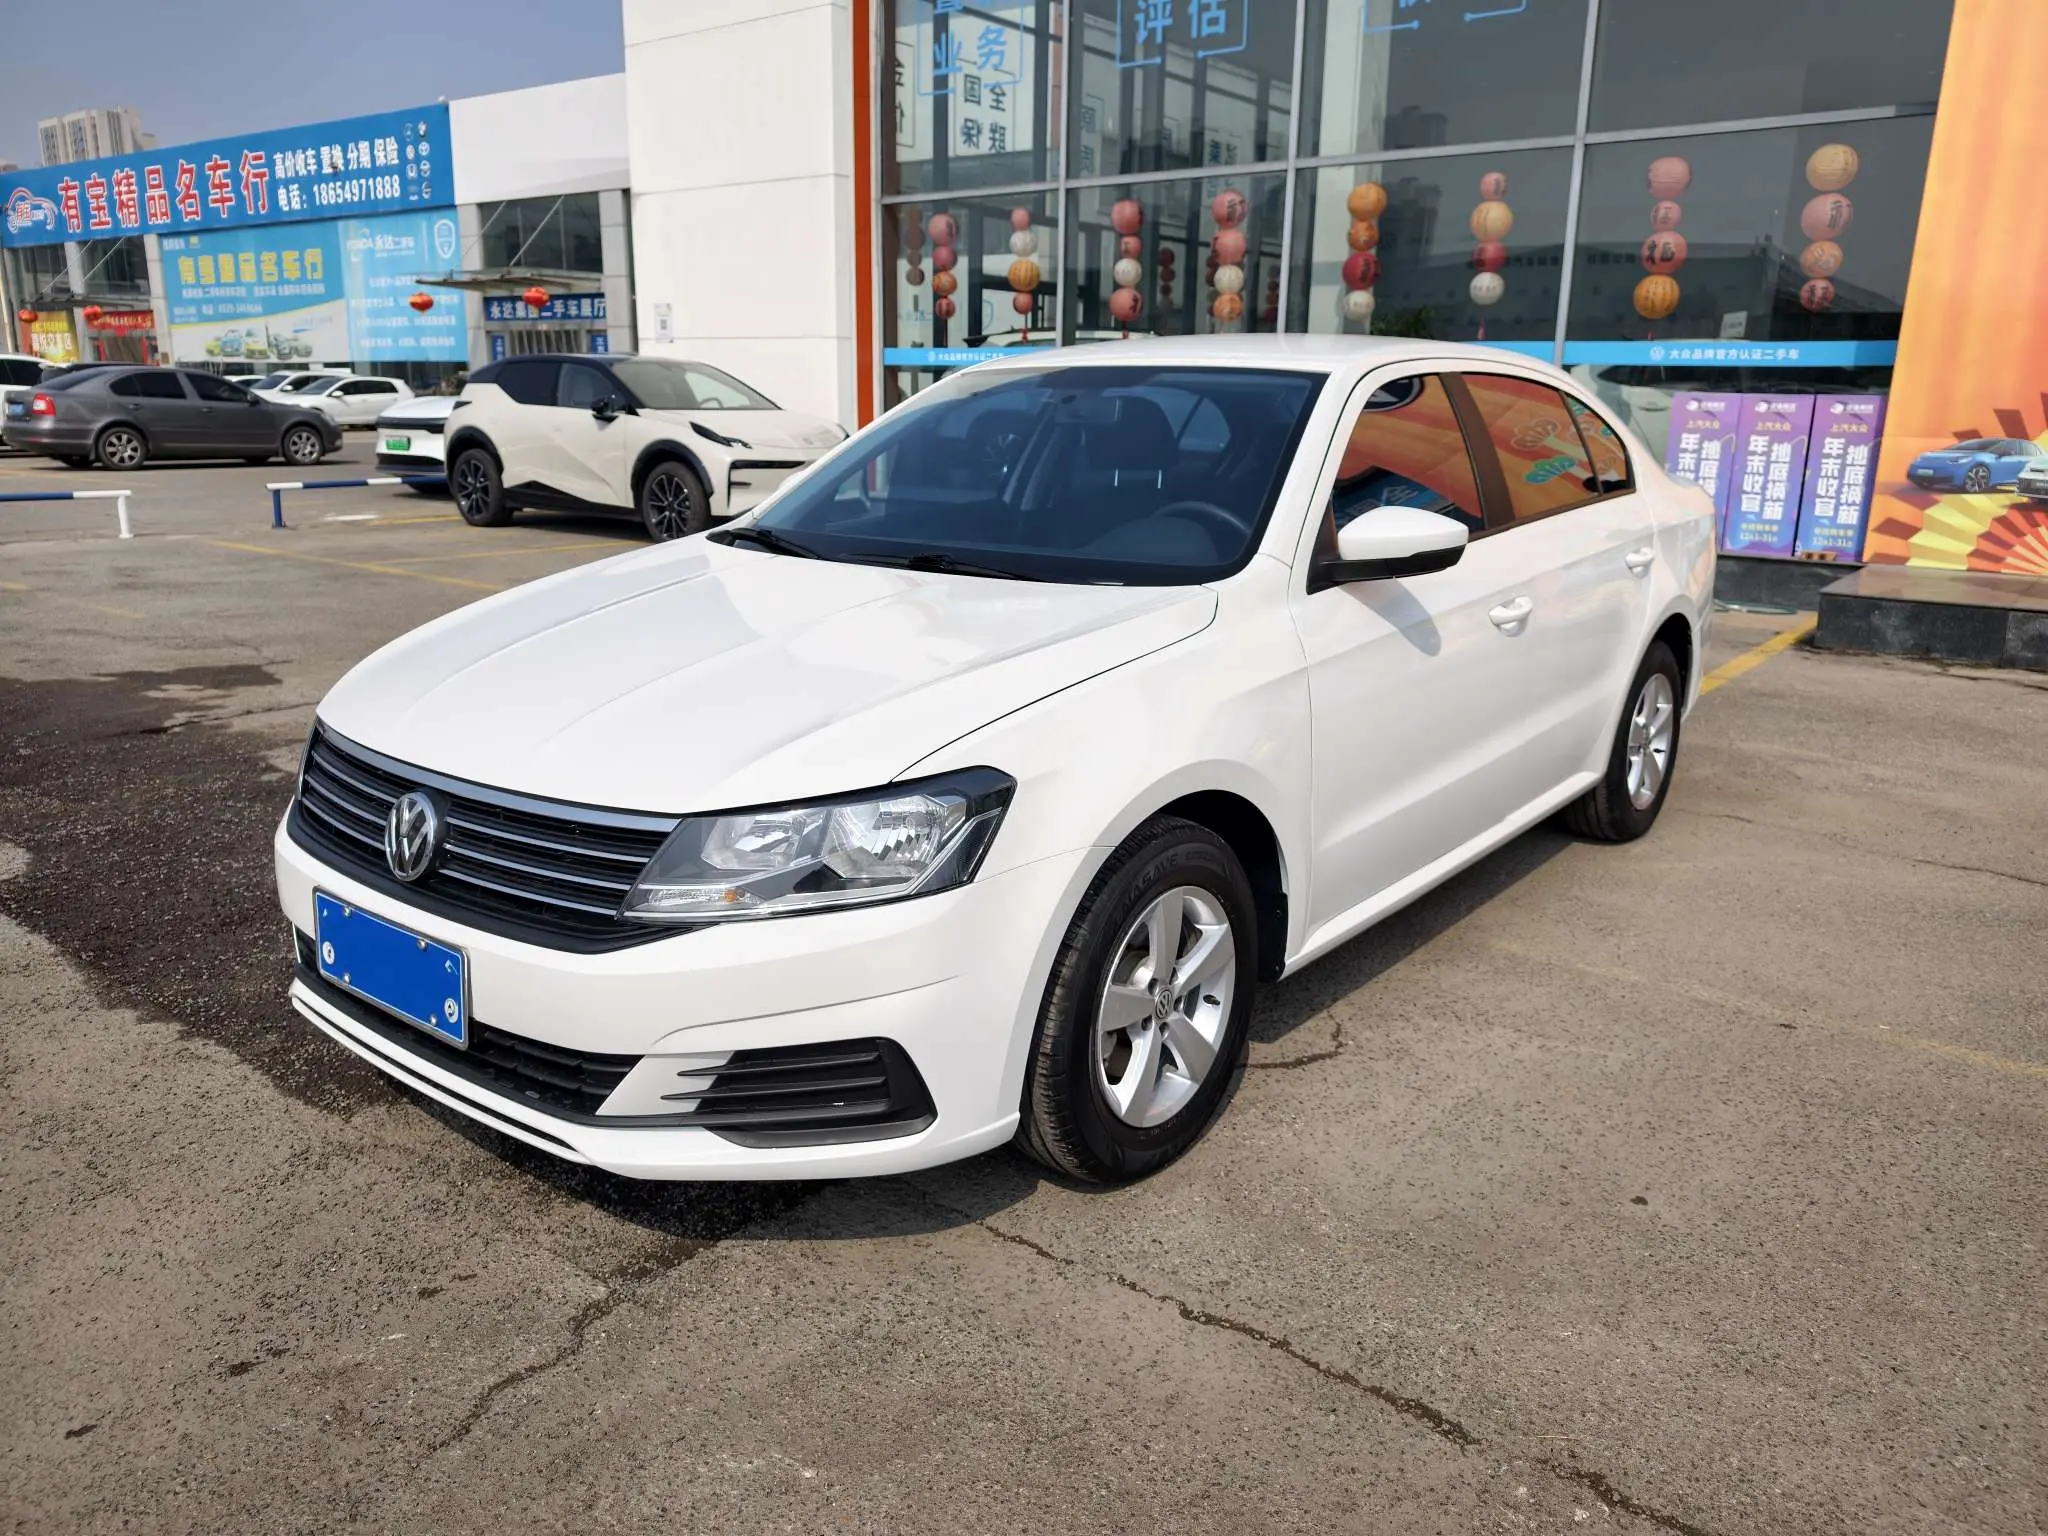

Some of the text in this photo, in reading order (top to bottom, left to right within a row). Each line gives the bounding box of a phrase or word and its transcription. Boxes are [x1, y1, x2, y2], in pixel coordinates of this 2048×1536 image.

[1134, 0, 1226, 44] 评估
[933, 26, 1007, 76] 业务
[273, 147, 318, 180] 高价收车
[347, 140, 372, 170] 分期
[374, 136, 399, 167] 保险
[58, 149, 270, 234] 有宝精品名车行
[1669, 348, 1800, 361] 大众品牌官方认证二手车
[1755, 421, 1792, 432] 上汽大众
[1829, 423, 1869, 433] 上汽大众
[1741, 434, 1770, 512] 年末收官
[1814, 437, 1846, 517] 年末收官
